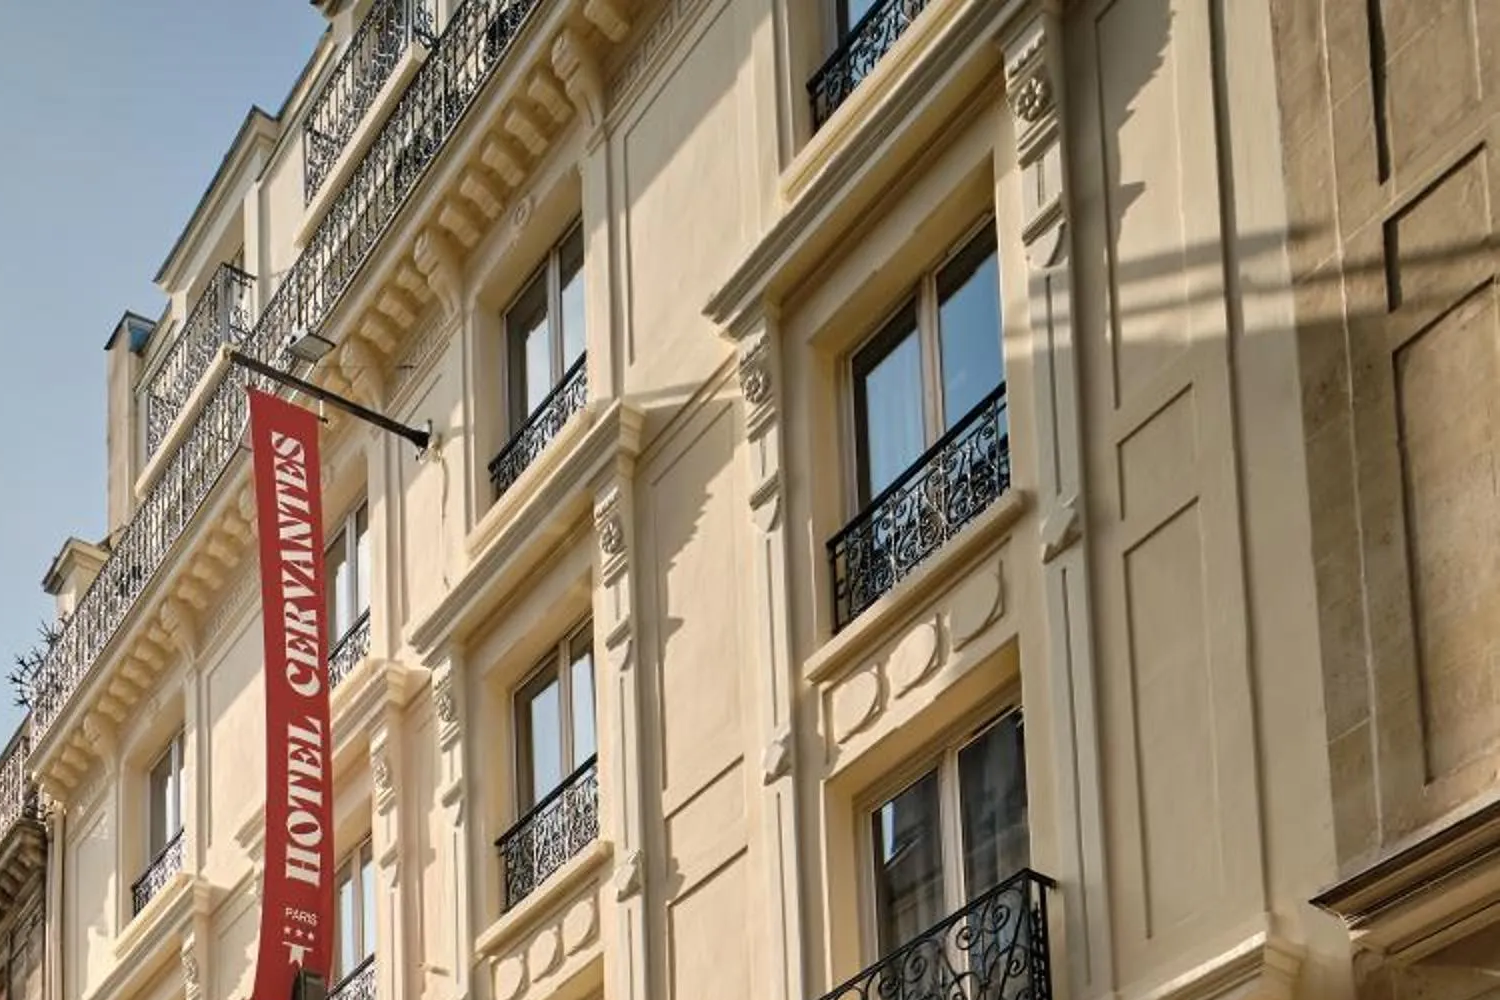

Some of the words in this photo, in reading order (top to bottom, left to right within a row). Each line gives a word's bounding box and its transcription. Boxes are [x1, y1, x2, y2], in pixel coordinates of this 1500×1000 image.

[272, 431, 321, 697] CERVANTES
[285, 716, 323, 887] HOTEL
[284, 907, 317, 926] PARIS
